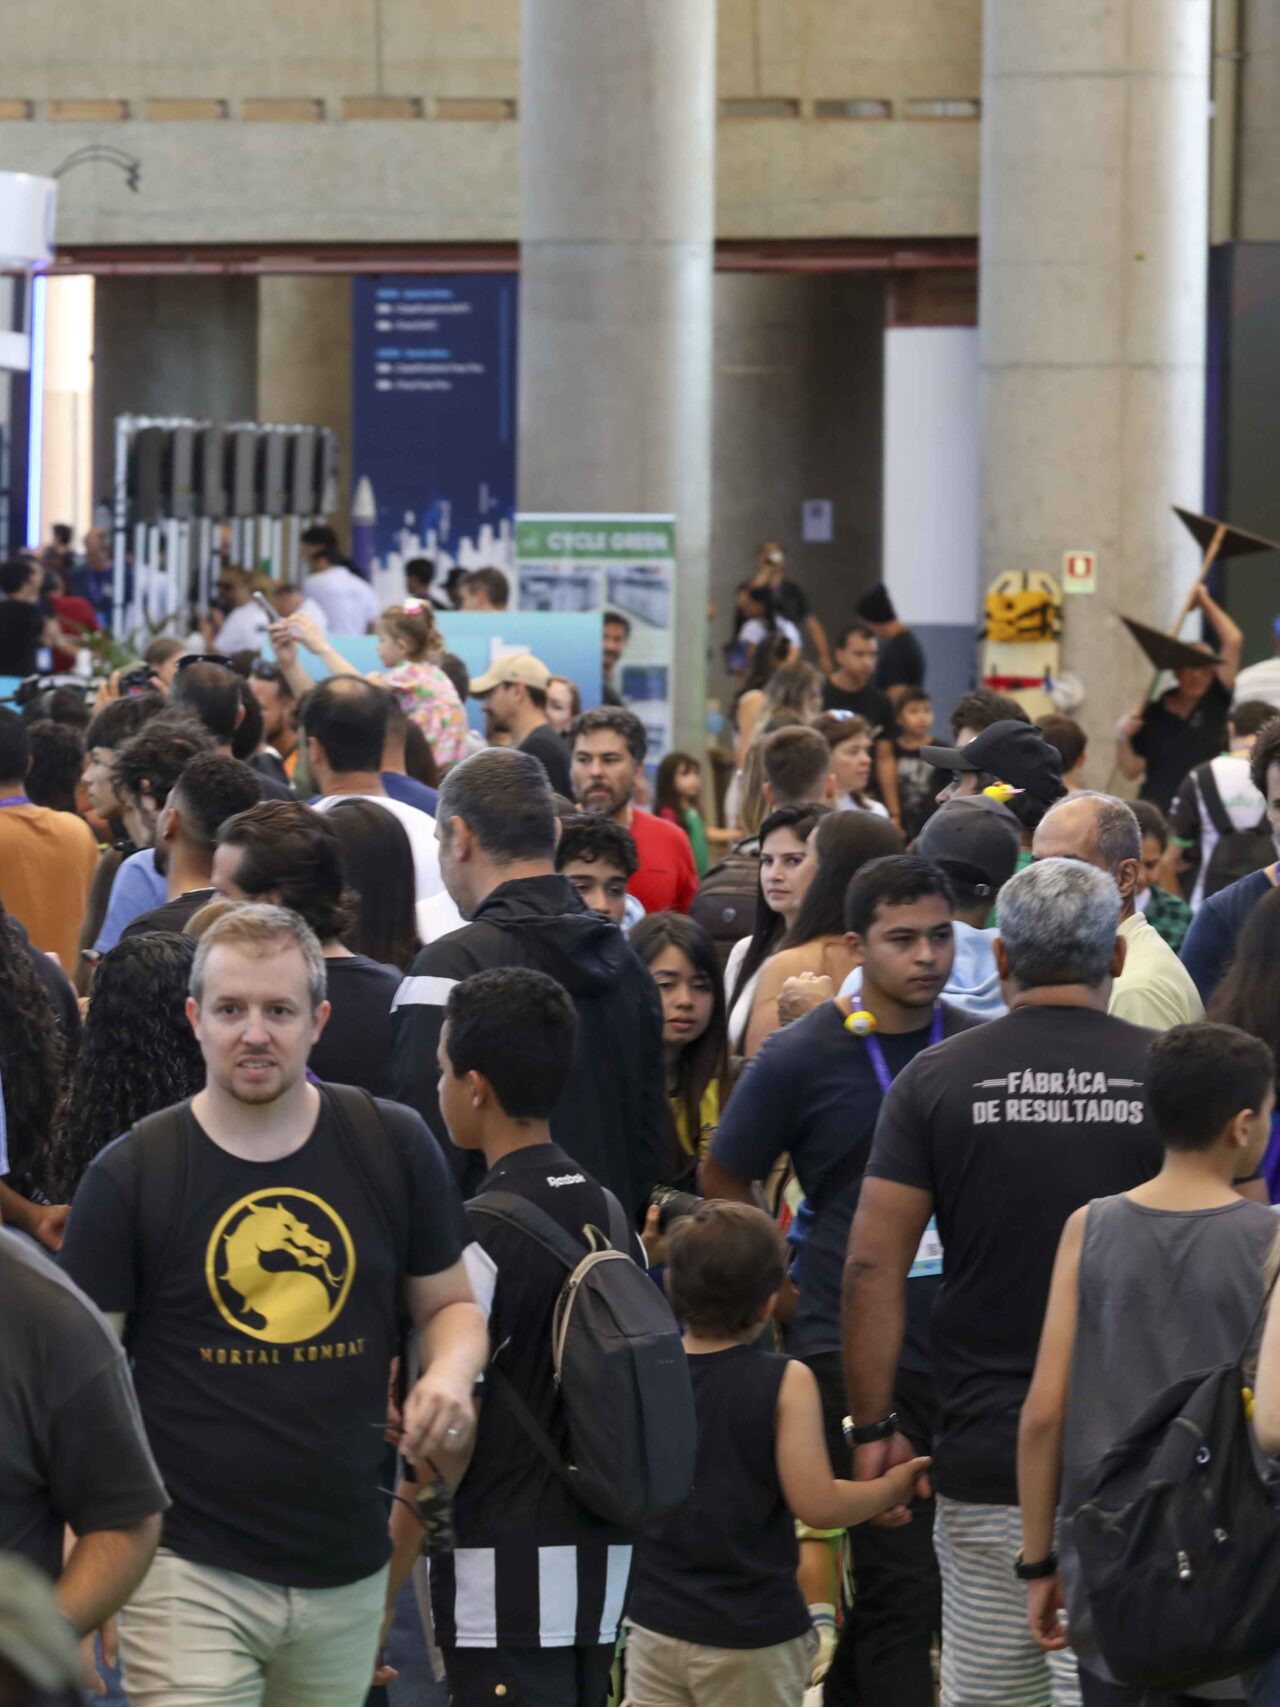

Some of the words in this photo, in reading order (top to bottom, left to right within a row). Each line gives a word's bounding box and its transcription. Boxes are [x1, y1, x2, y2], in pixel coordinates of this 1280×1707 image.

[546, 530, 606, 552] CYCLE
[610, 532, 669, 552] GREEN
[971, 1100, 1002, 1126] DE
[1005, 1098, 1145, 1126] RESULTADOS
[199, 1346, 281, 1365] MORTAL
[292, 1337, 365, 1363] KOMBAT
